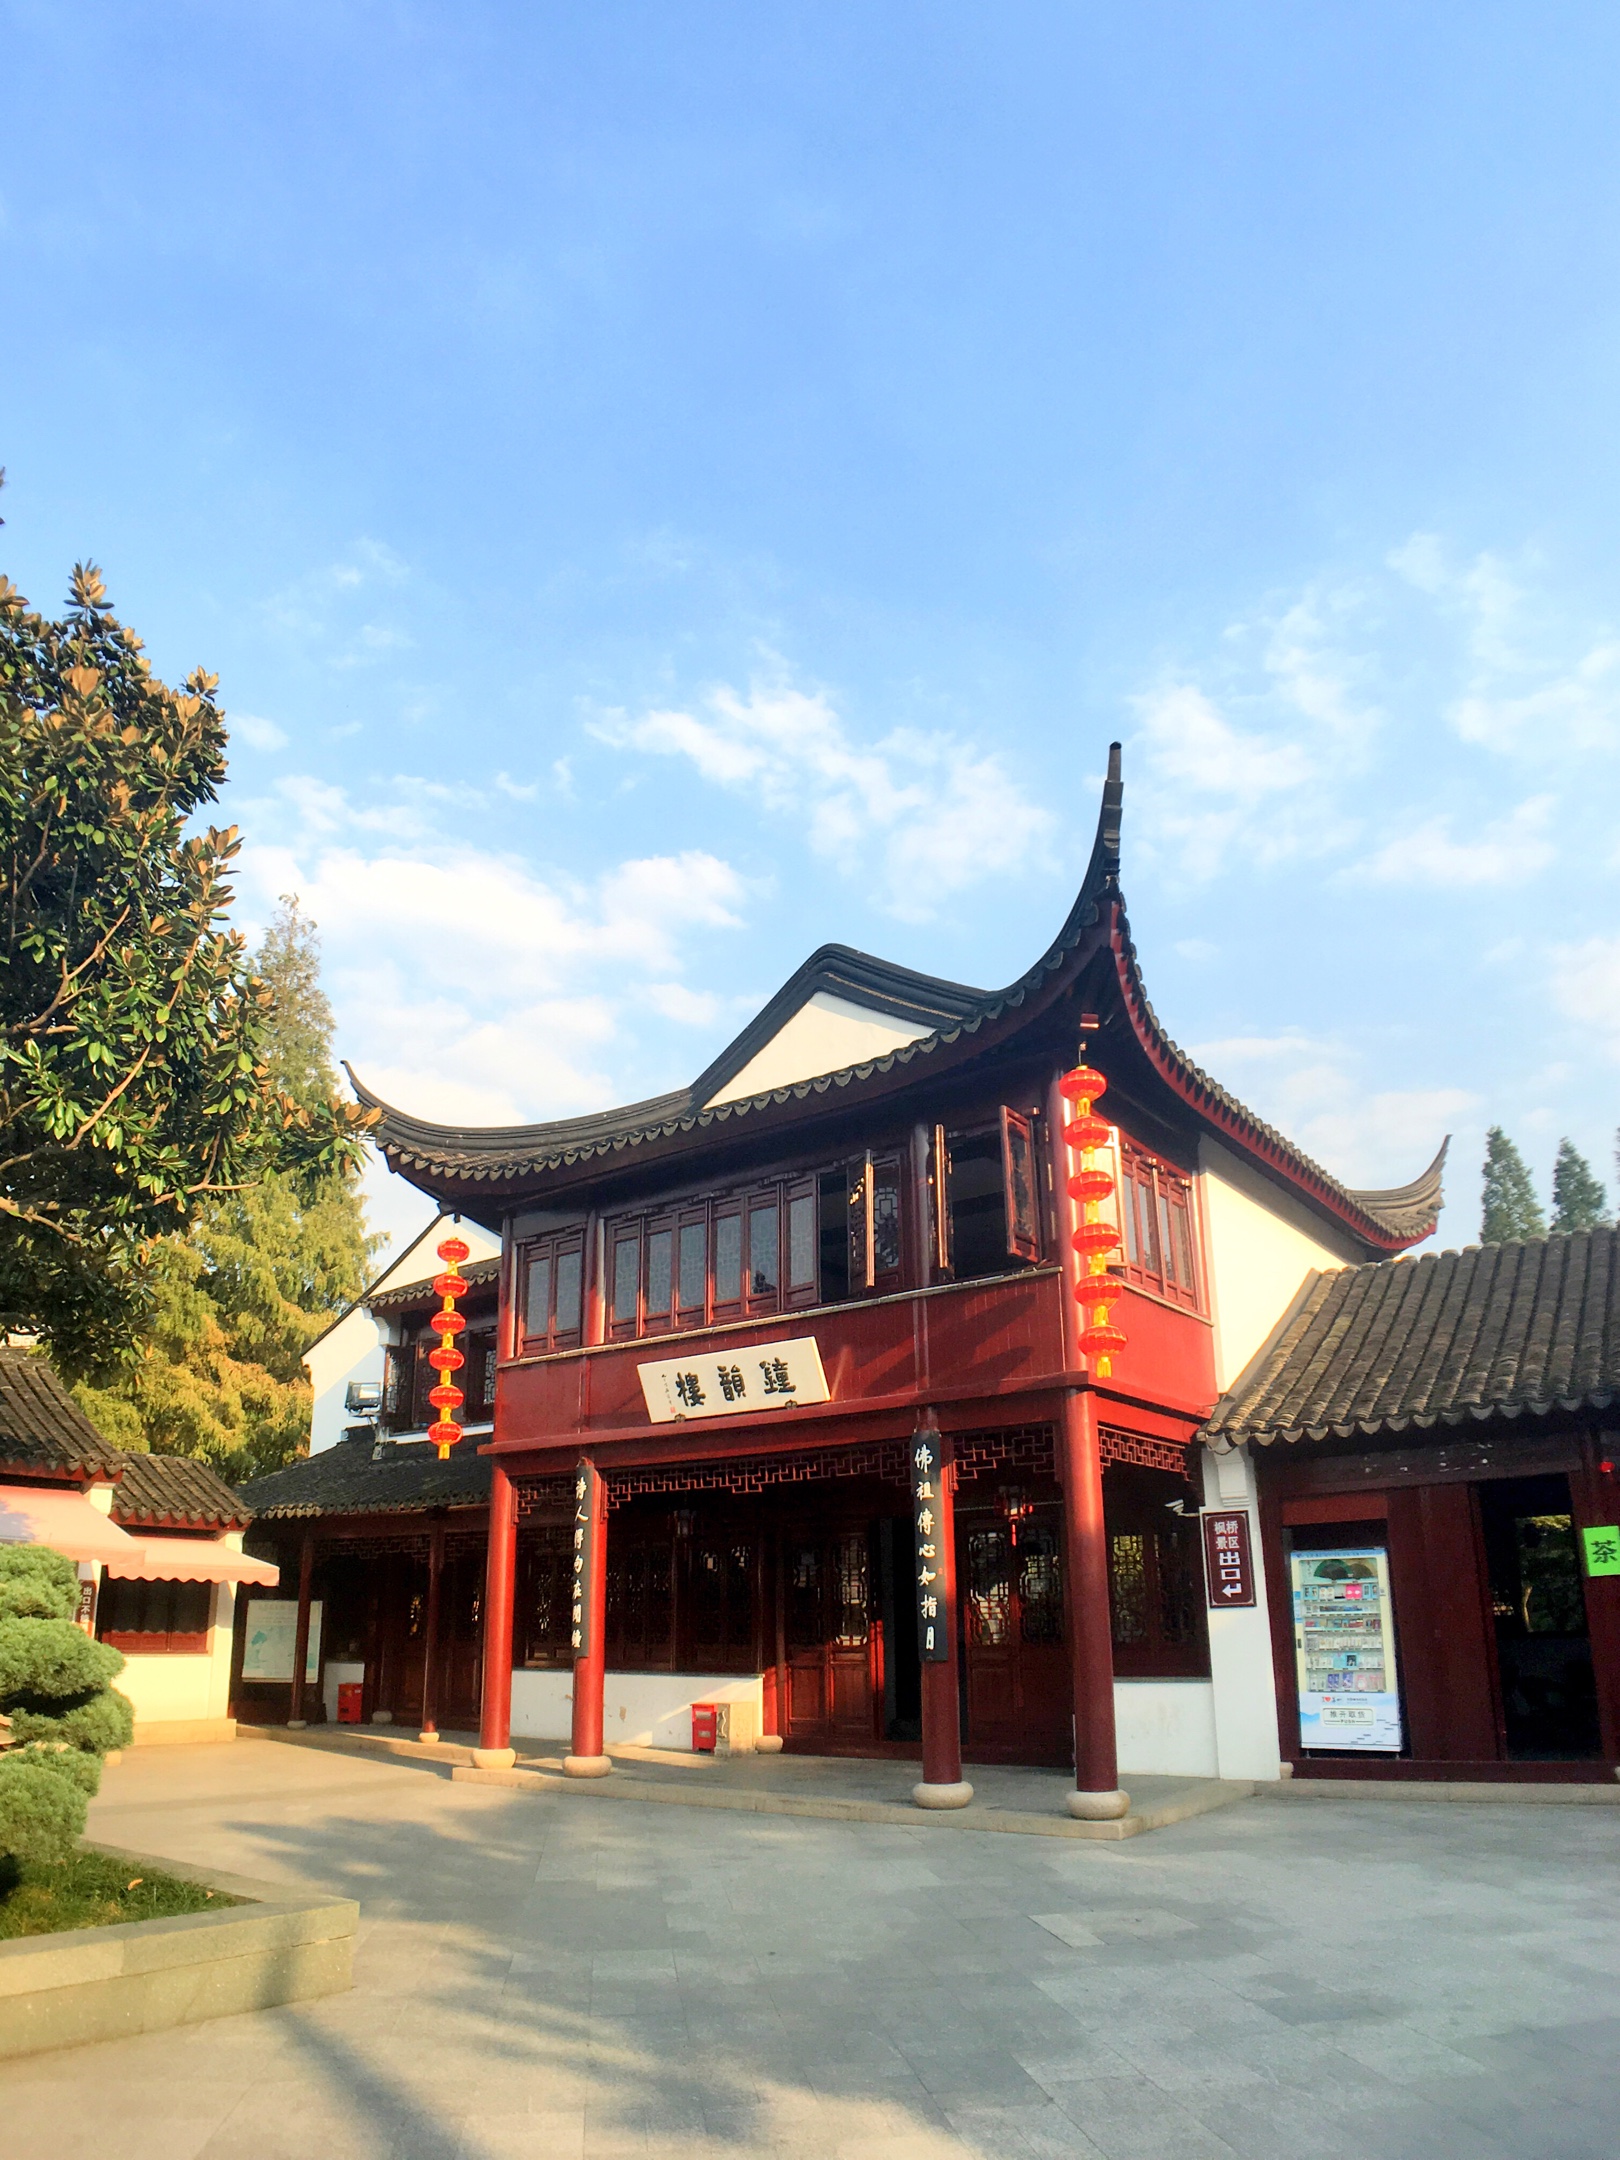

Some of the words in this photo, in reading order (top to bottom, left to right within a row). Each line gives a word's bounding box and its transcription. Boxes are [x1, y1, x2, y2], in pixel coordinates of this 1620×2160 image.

[1214, 1520, 1239, 1535] 枫桥
[1215, 1535, 1240, 1550] 景区
[1590, 1539, 1618, 1564] 茶
[1219, 1551, 1241, 1580] 出口
